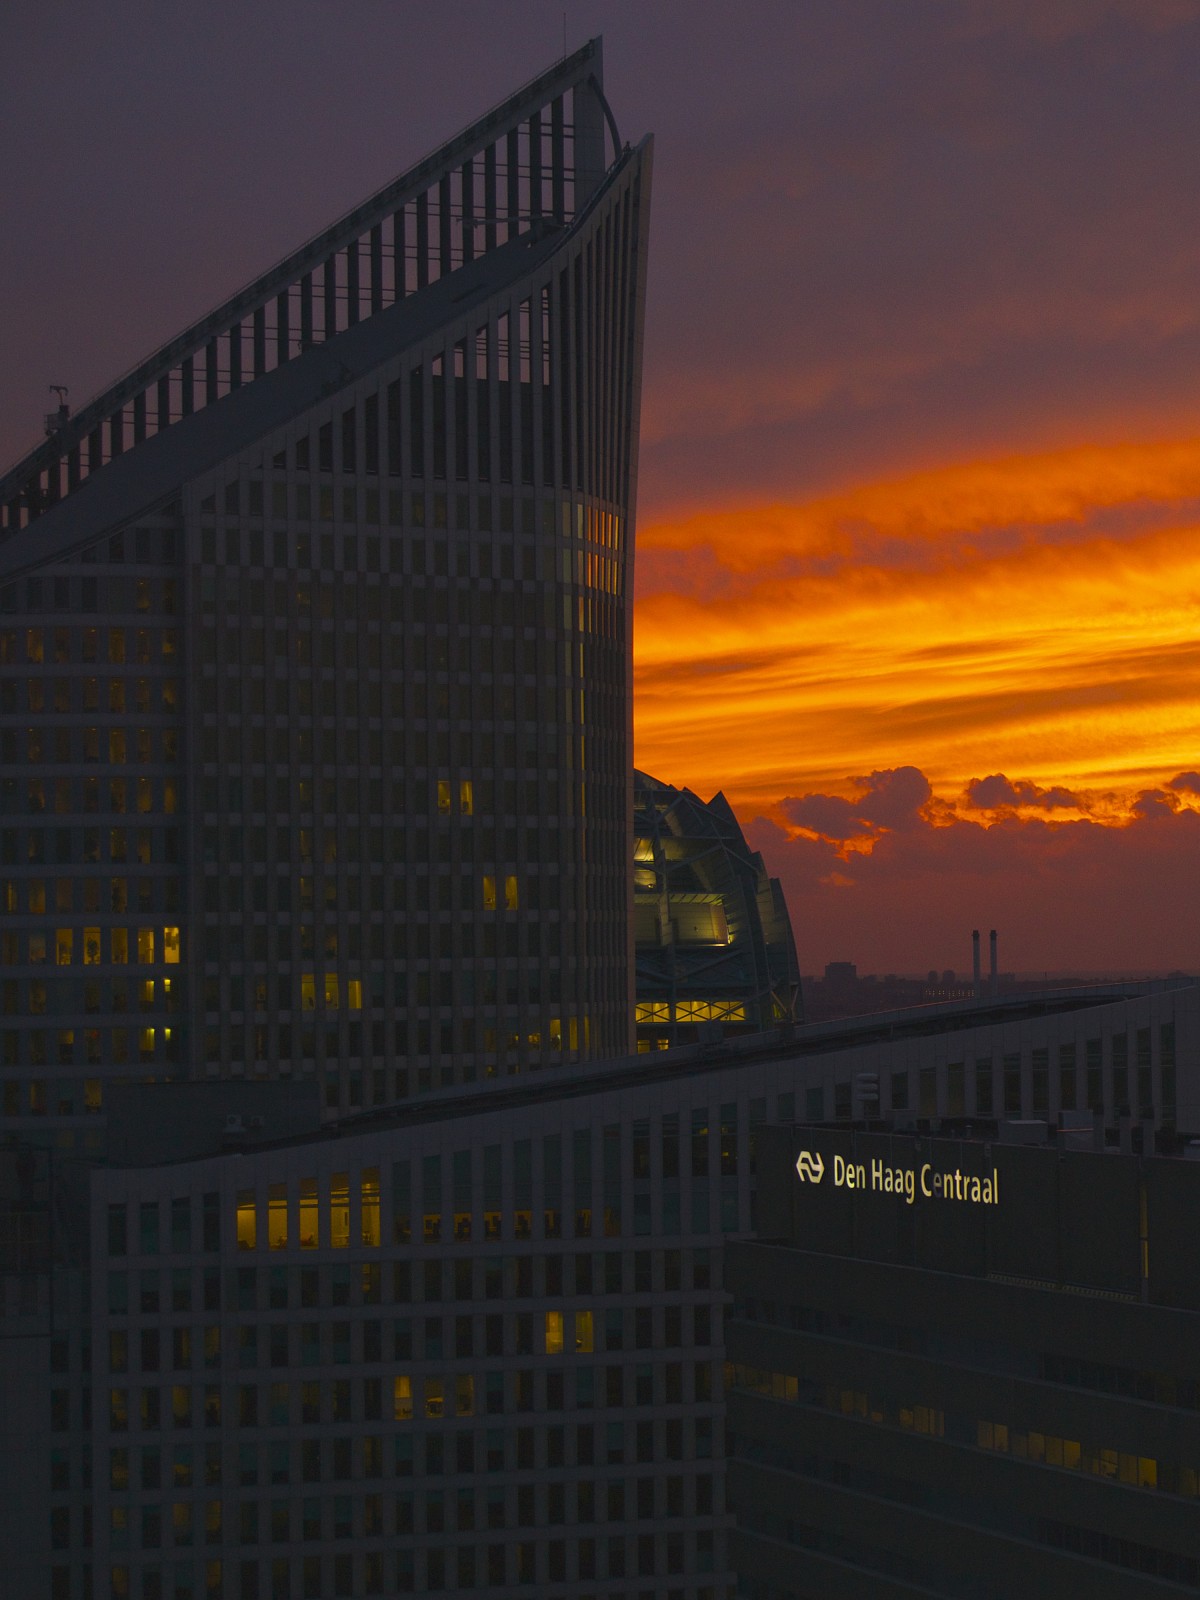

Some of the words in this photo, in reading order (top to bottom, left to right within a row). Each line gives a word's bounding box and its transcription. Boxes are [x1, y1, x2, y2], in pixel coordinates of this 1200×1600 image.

[834, 1155, 866, 1189] Den
[871, 1158, 915, 1205] Haag
[921, 1163, 999, 1204] Centraal
